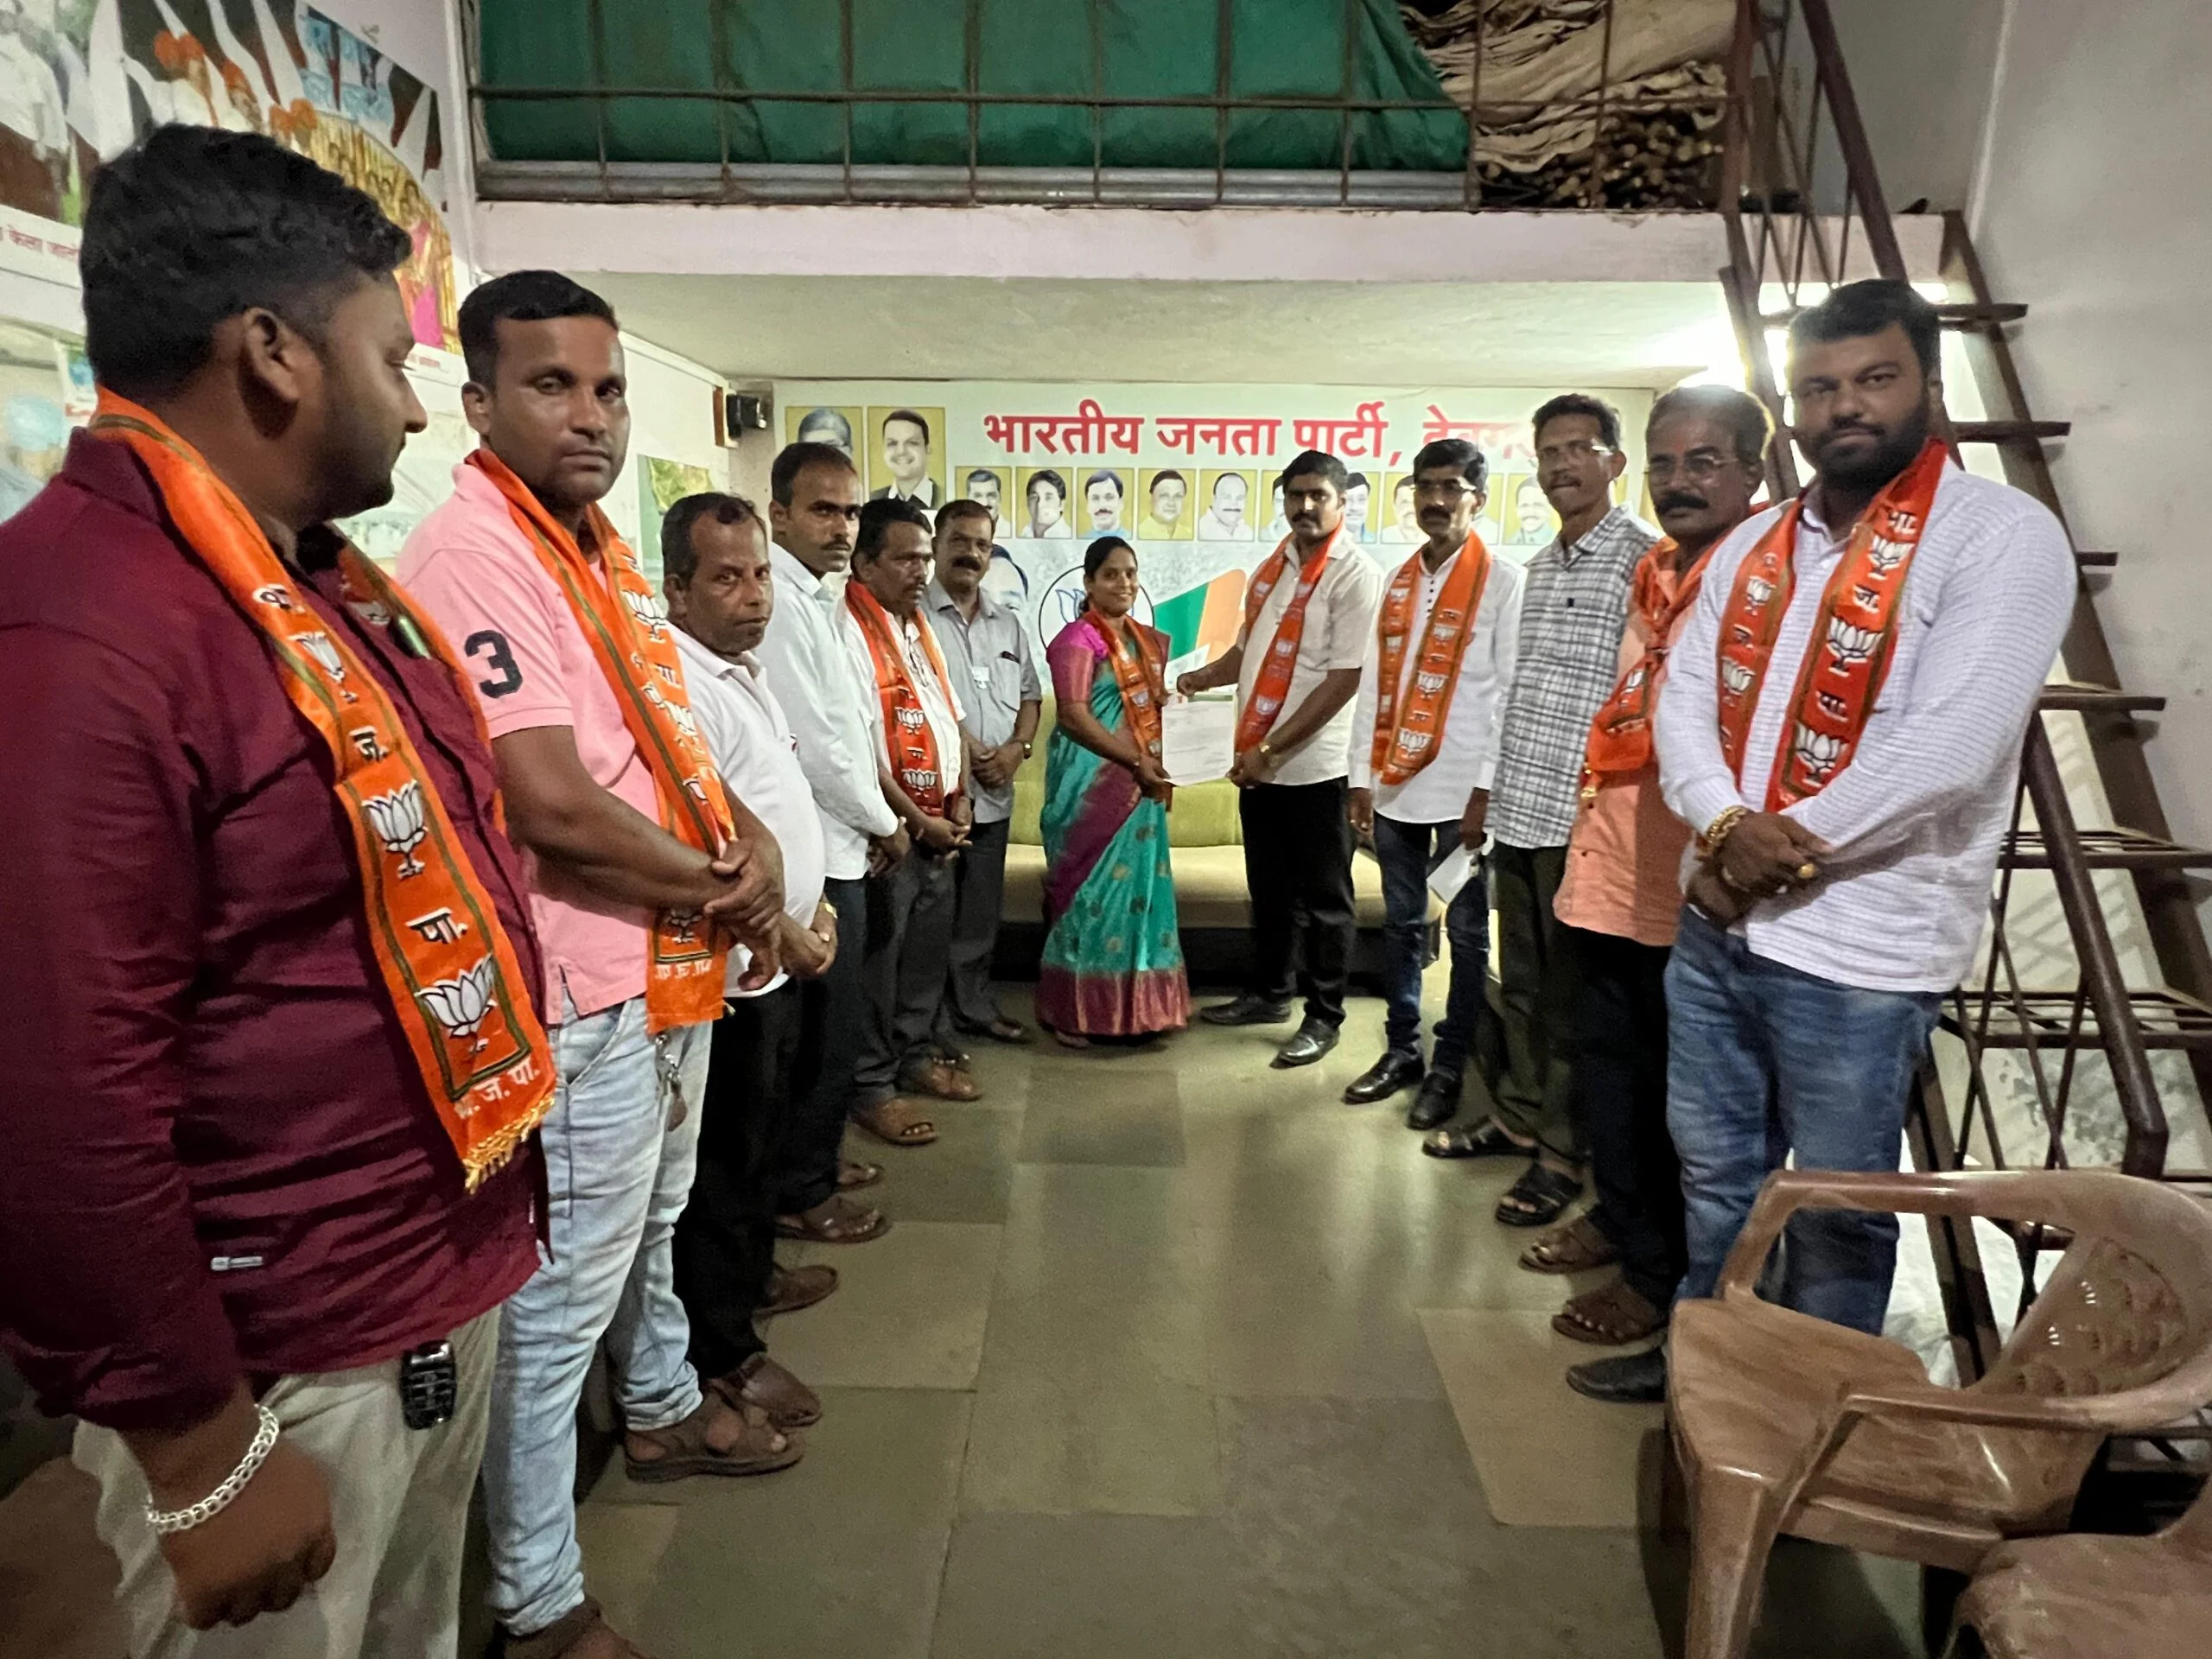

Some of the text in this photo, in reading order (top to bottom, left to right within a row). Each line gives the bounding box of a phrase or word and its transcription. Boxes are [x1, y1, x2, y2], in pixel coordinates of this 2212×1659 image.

[983, 398, 1145, 455] भारतीय
[1155, 417, 1281, 456] जनता
[464, 629, 523, 699] 3
